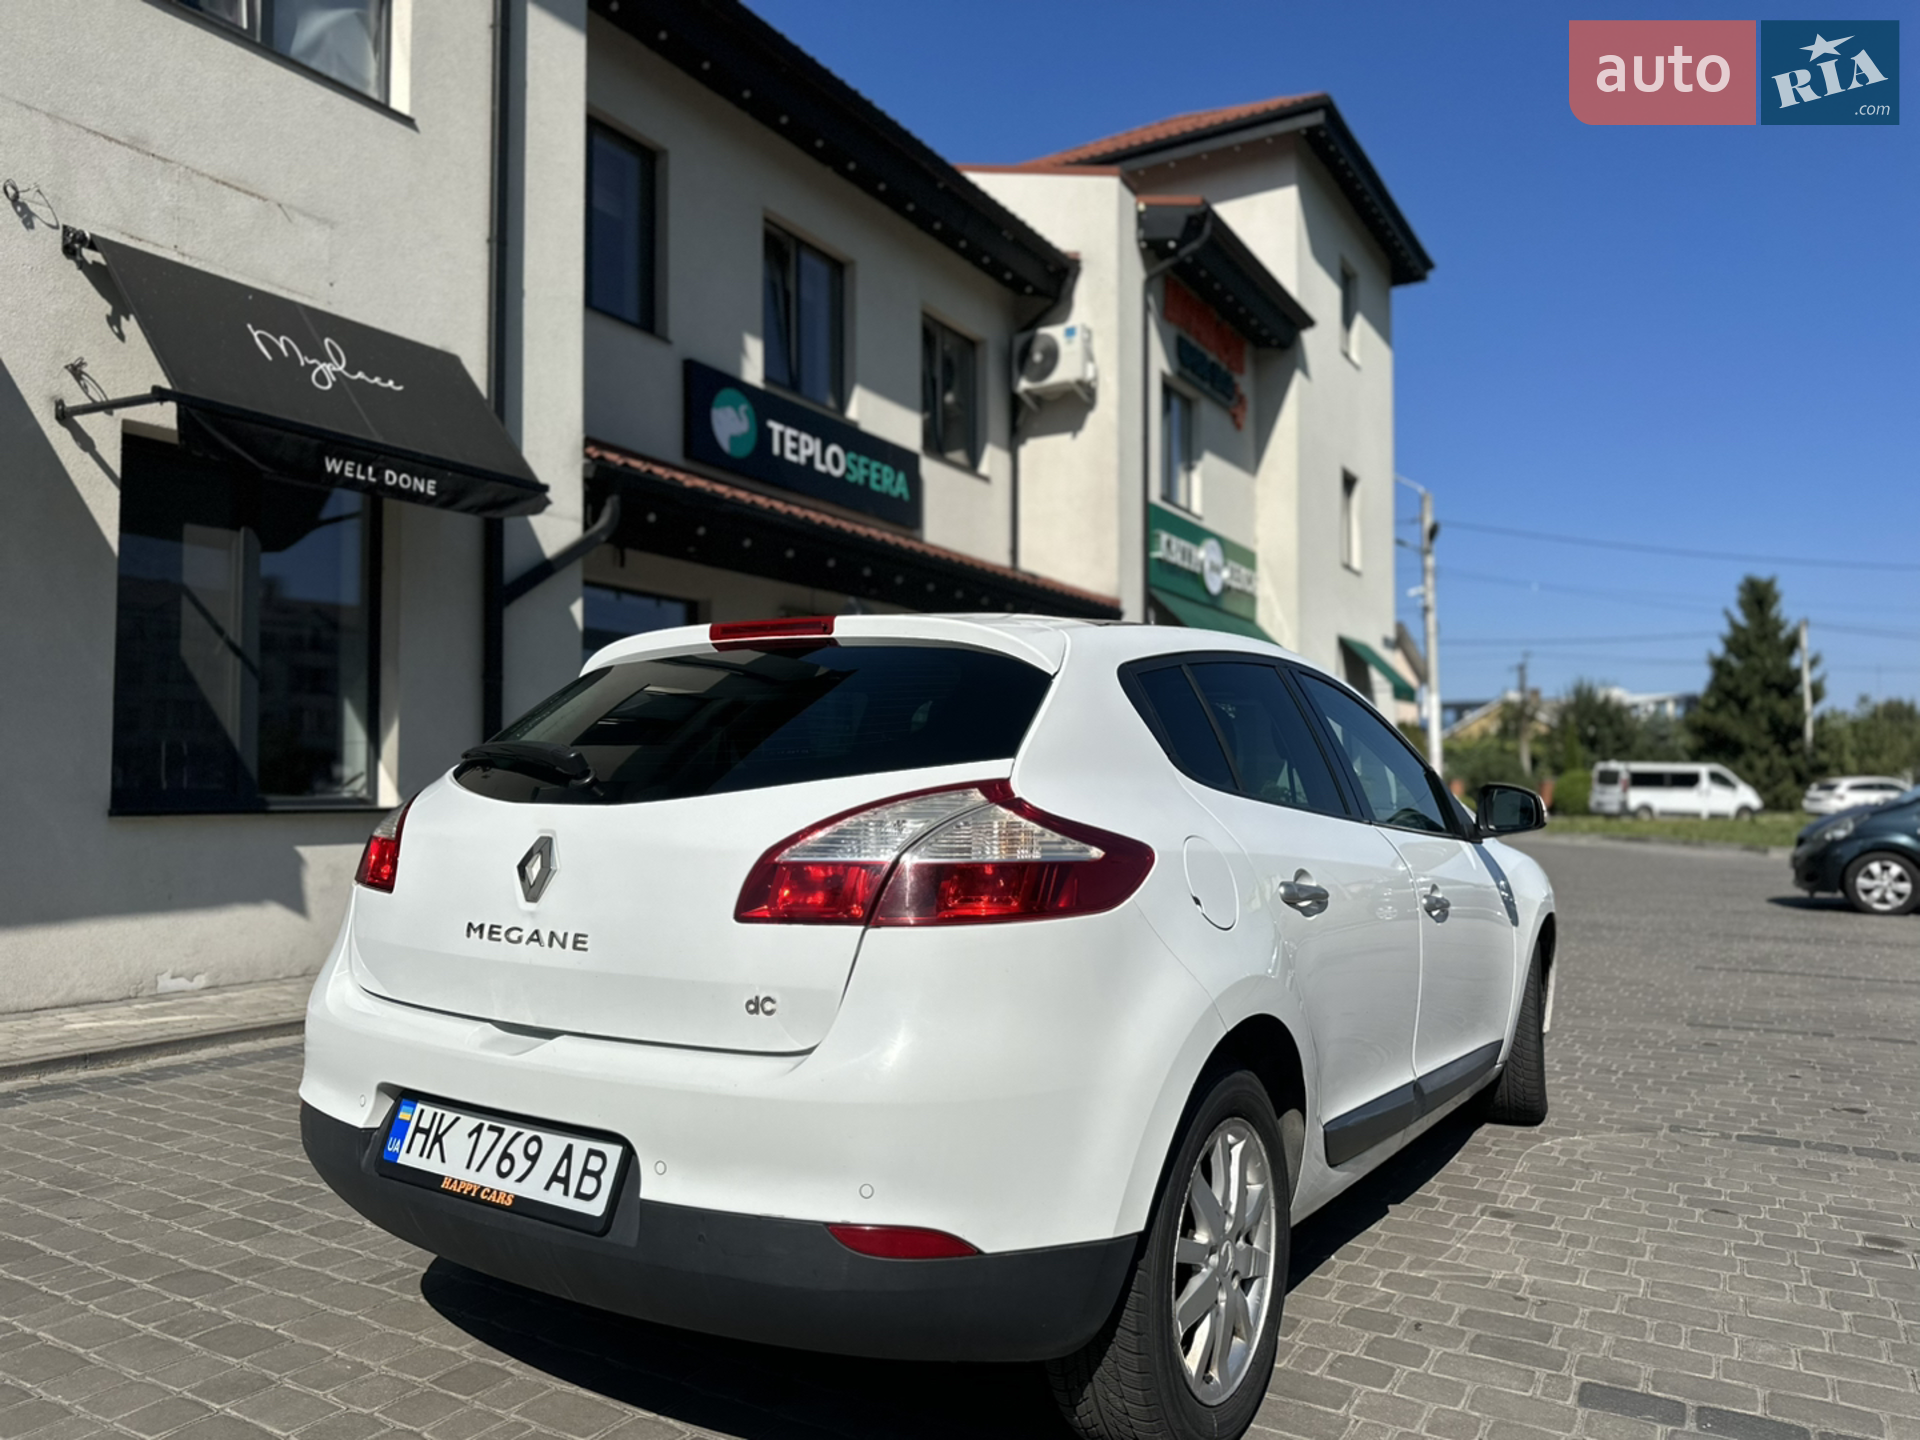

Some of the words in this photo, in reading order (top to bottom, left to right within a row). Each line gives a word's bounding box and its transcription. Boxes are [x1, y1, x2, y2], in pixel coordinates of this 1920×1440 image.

[766, 419, 910, 501] TEPLOSFERA
[324, 456, 377, 482] WELL
[384, 469, 437, 496] DONE
[465, 921, 589, 952] MEGANE
[745, 995, 777, 1016] dC
[387, 1136, 401, 1153] UA
[405, 1108, 461, 1164] HK
[467, 1121, 543, 1183] 1769
[543, 1142, 607, 1202] AB
[440, 1176, 480, 1197] HAPPY
[480, 1187, 515, 1206] CARS
